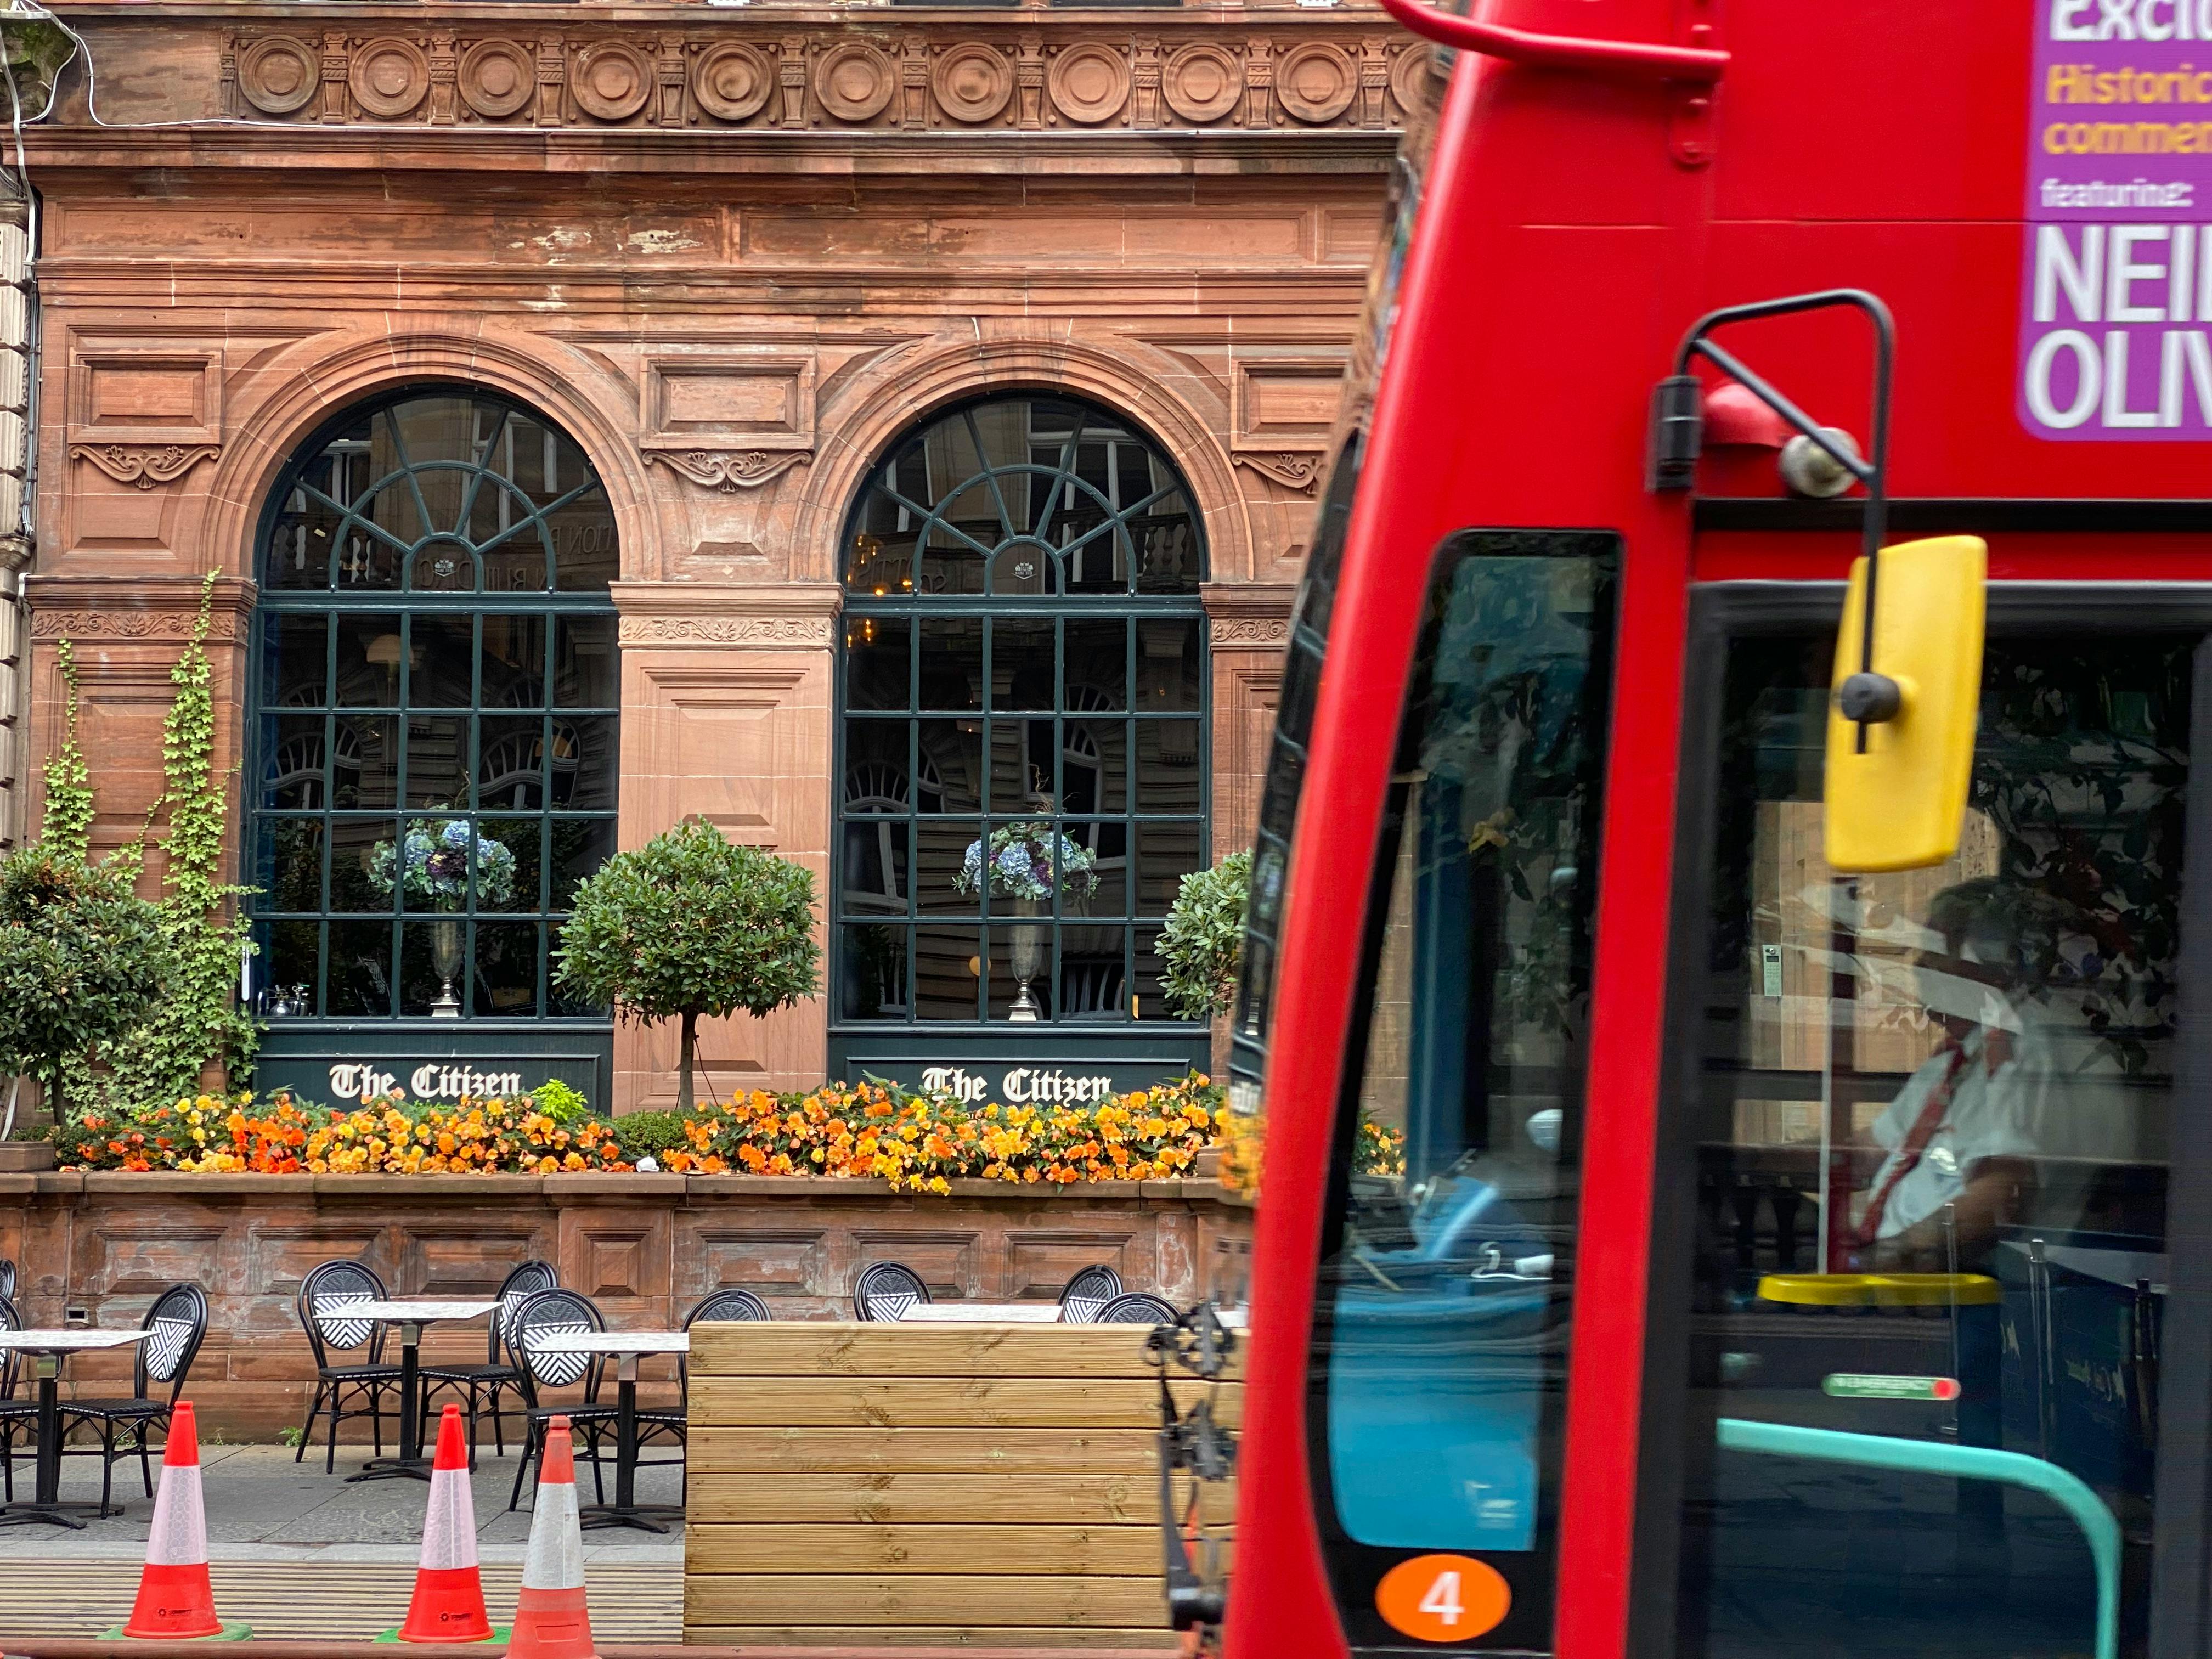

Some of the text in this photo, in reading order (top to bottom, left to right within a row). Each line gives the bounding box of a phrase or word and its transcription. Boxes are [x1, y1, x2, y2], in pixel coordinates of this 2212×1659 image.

[329, 1063, 521, 1099] The Citizen
[922, 1066, 1112, 1108] The Citizen
[1418, 1571, 1465, 1625] 4
